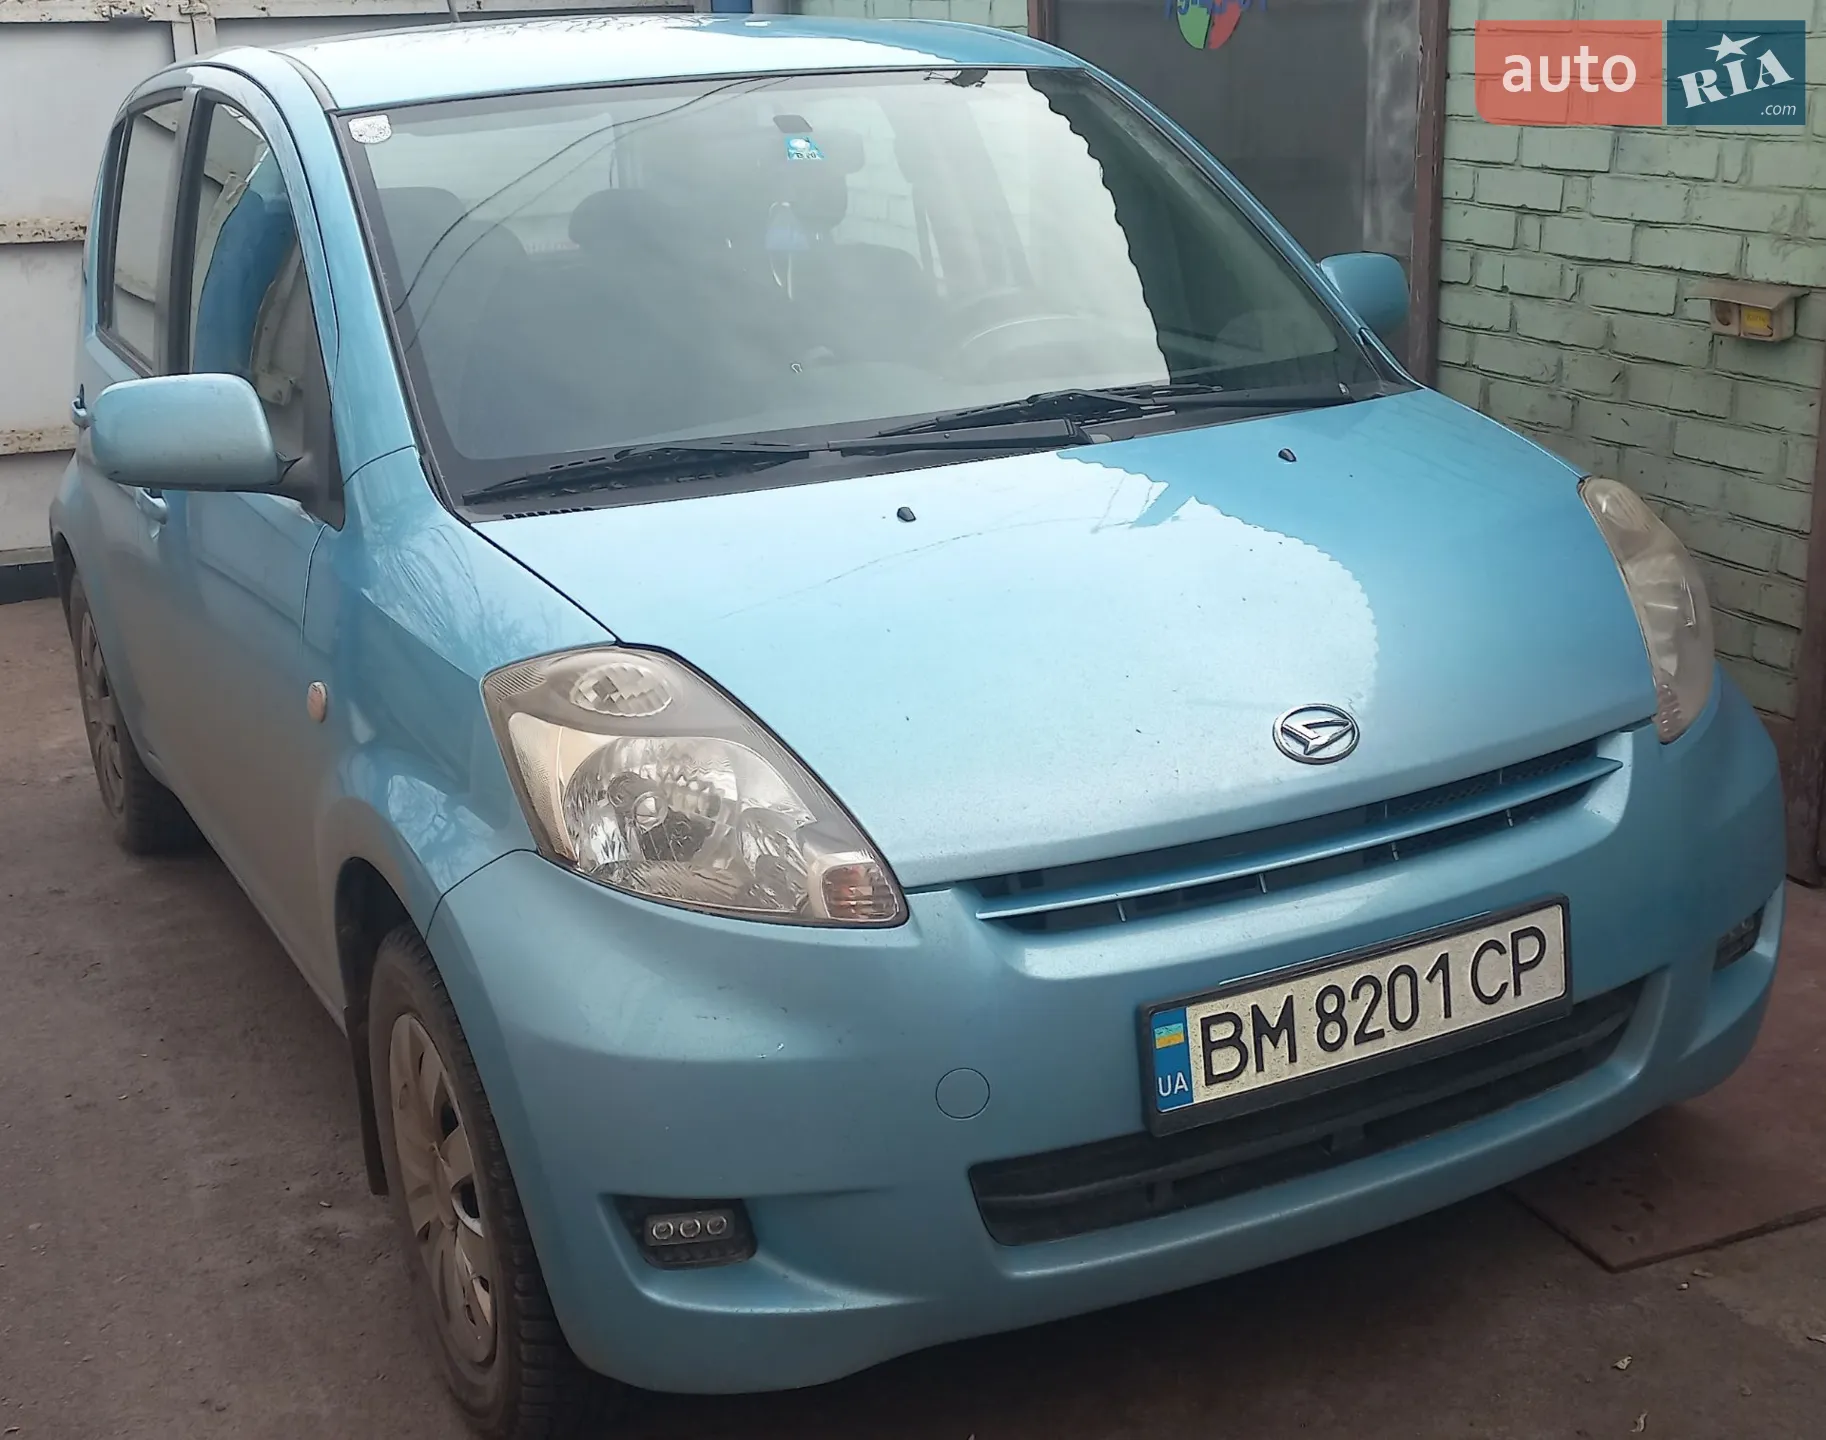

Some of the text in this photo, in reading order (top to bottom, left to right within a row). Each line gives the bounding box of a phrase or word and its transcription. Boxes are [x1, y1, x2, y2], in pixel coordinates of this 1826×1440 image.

[1200, 925, 1547, 1087] BM 8201 CP
[1157, 1071, 1189, 1098] UA
